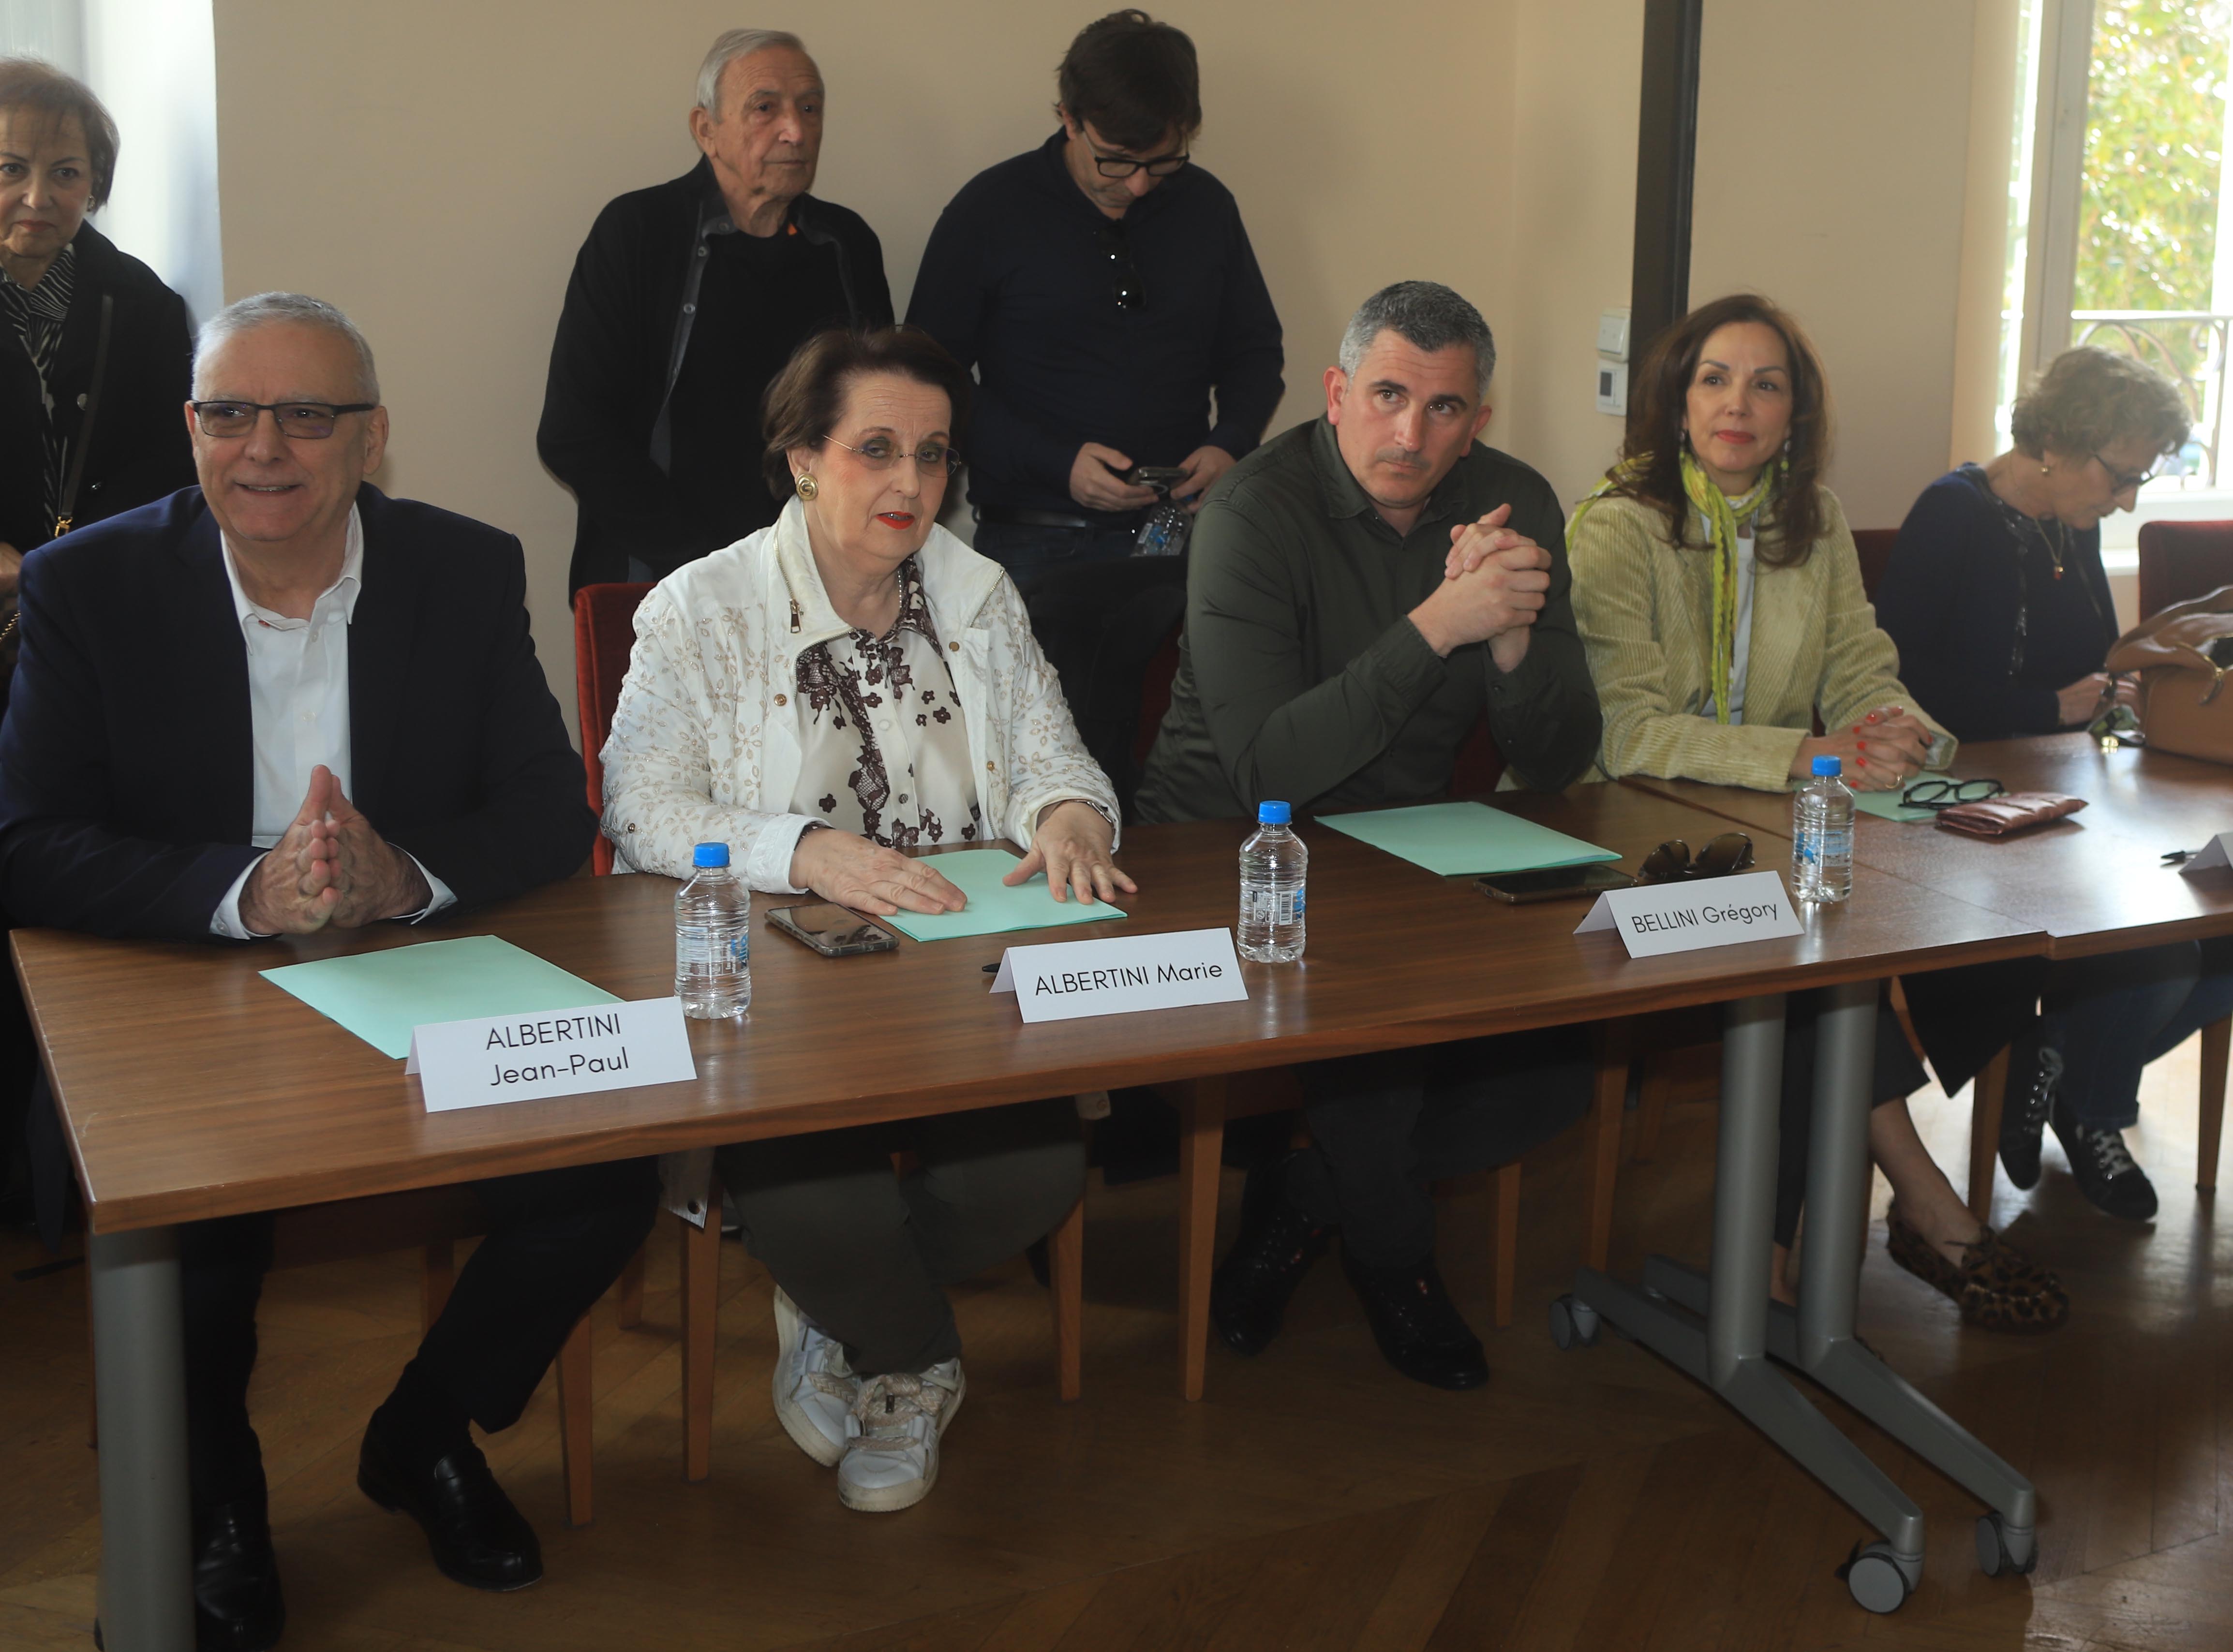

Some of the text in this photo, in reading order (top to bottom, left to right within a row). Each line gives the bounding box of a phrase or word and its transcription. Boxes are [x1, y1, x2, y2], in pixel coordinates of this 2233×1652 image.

[1631, 903, 1777, 933] BELLINI Grégory
[1035, 962, 1222, 996] ALBERTINI Marie
[486, 1013, 621, 1050] ALBERTINI
[490, 1046, 629, 1086] Jean-Paul
